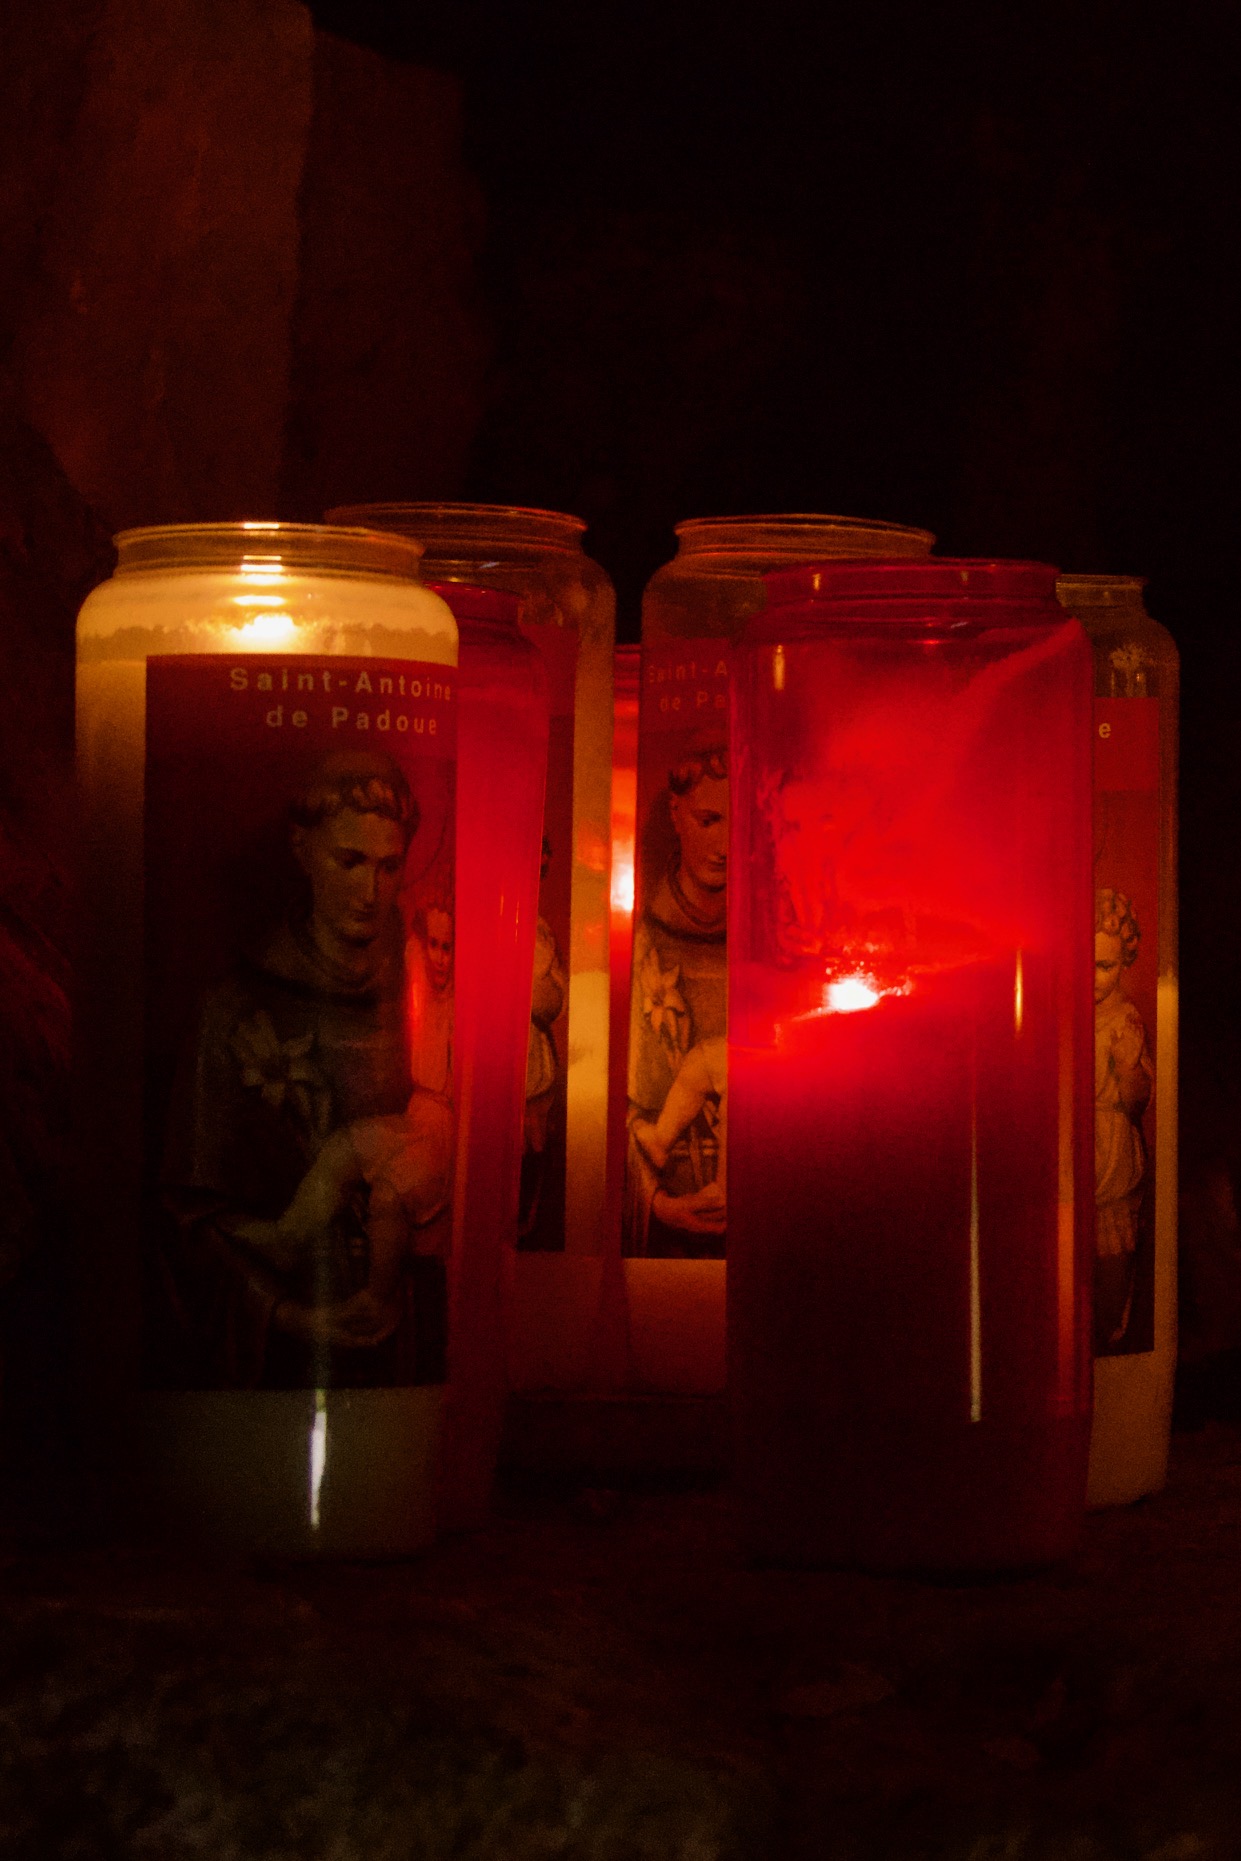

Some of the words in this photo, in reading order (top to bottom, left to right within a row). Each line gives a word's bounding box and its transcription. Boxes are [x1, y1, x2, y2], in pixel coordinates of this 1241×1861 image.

[229, 667, 451, 701] Saint-Antoine
[265, 704, 309, 729] de
[331, 705, 438, 736] Padoue
